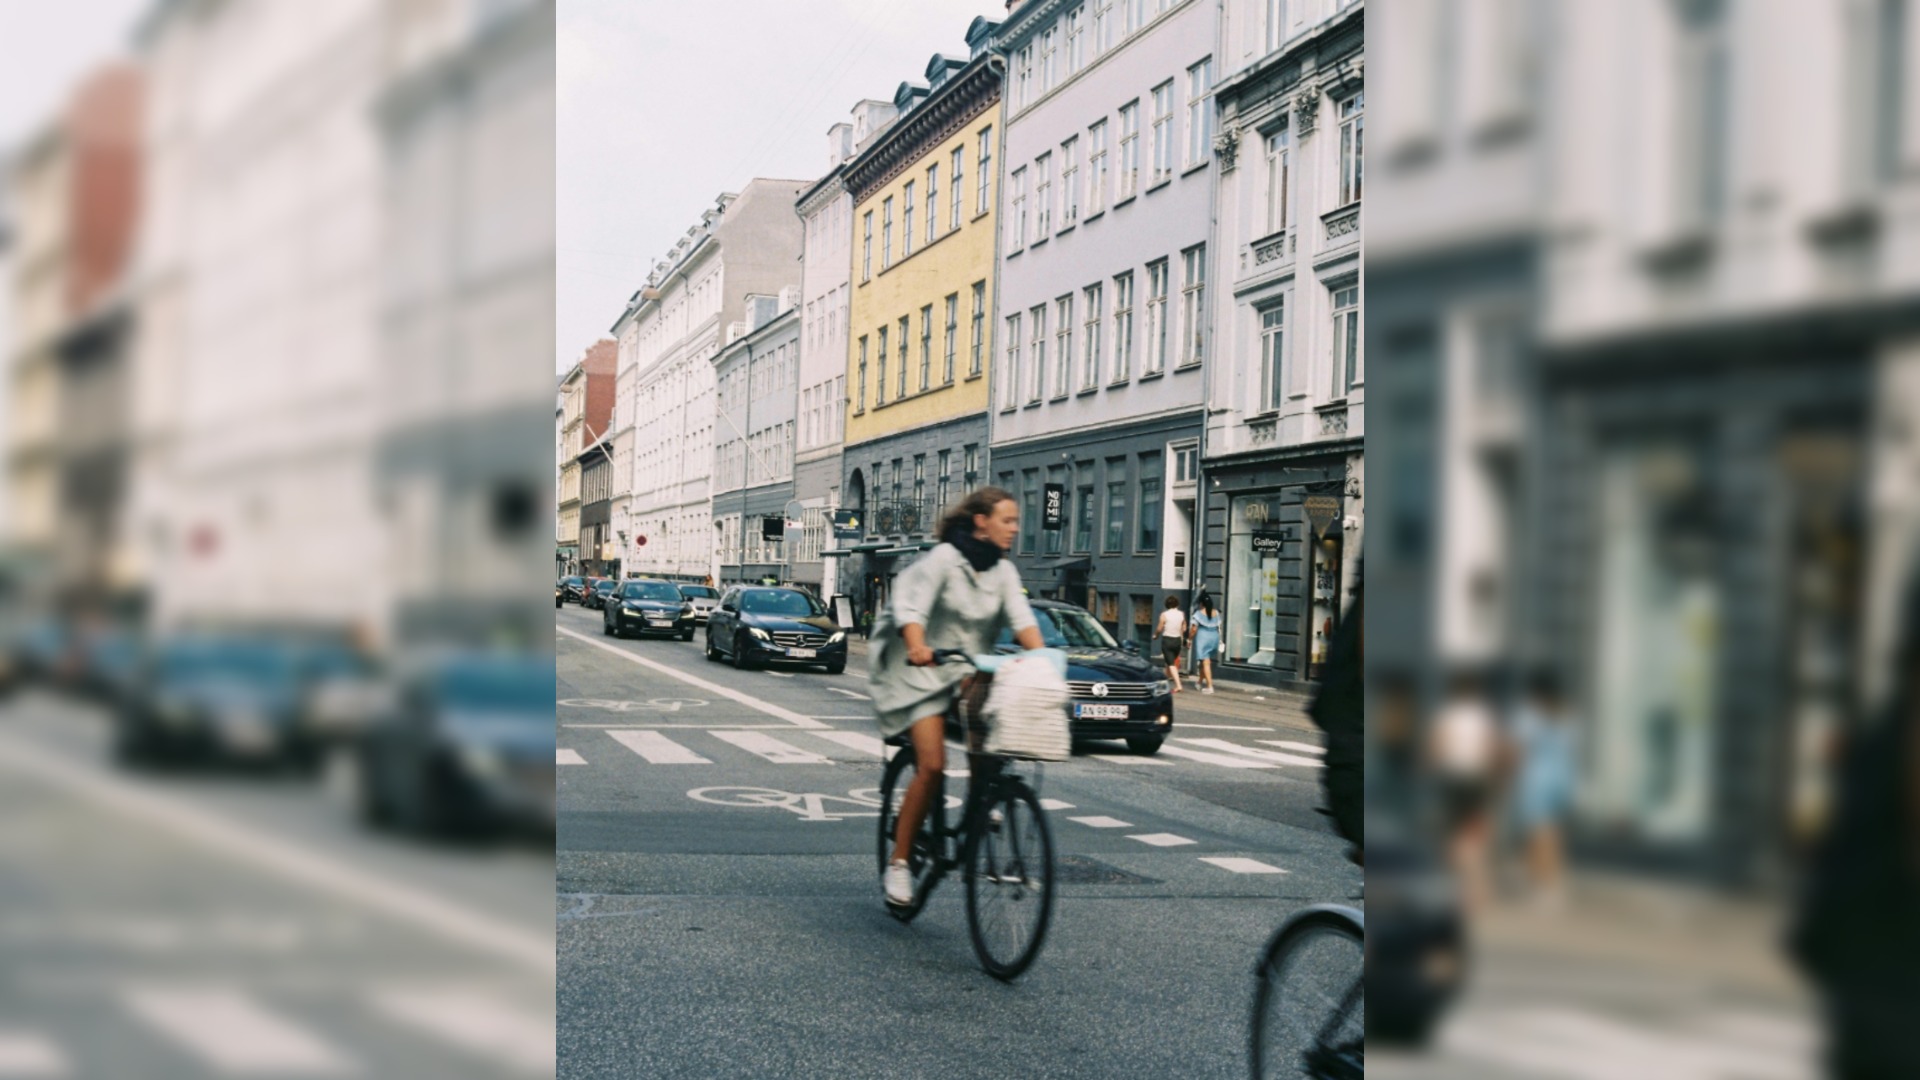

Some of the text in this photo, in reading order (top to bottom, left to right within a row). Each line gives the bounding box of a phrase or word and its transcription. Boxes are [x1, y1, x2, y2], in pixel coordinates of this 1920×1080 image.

[1047, 490, 1059, 499] NO
[1047, 499, 1059, 507] ZO
[1047, 508, 1058, 516] MI
[1253, 537, 1281, 548] Gallery
